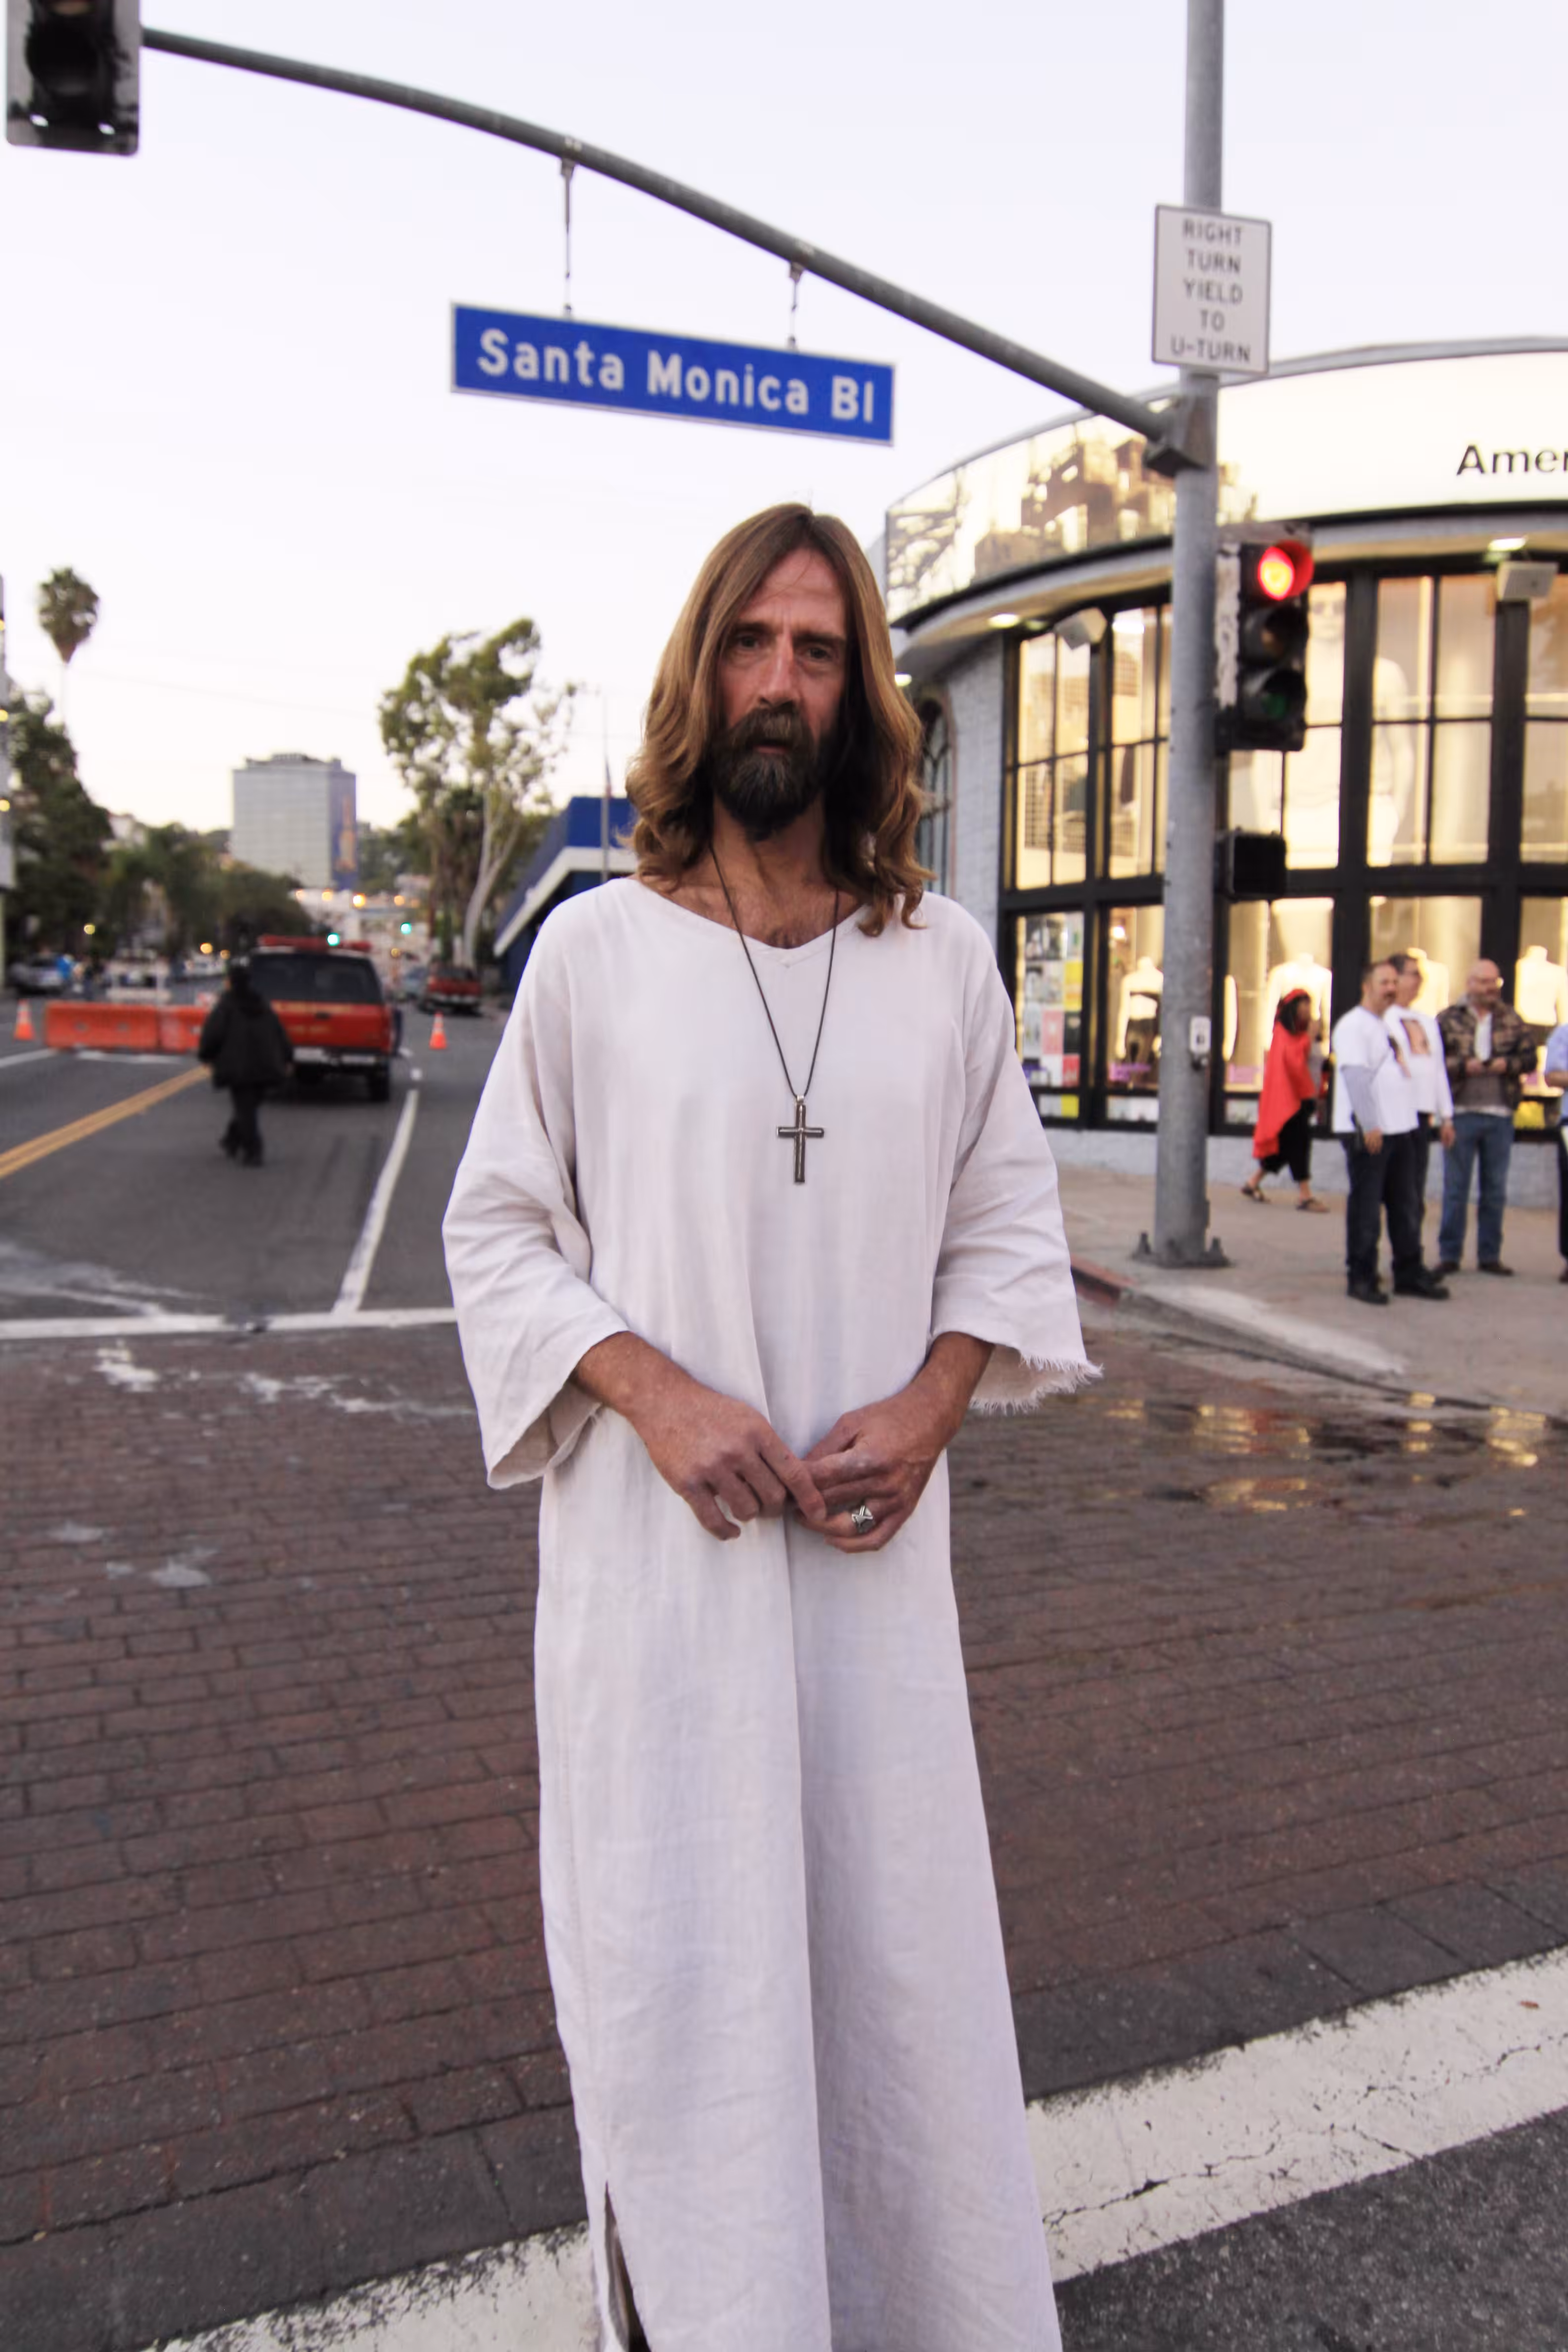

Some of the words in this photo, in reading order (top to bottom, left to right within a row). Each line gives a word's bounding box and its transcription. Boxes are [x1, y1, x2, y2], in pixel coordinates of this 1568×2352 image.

[1183, 219, 1242, 245] RIGHT
[1187, 248, 1241, 274] TURN
[1183, 278, 1243, 304] YIELD
[1200, 309, 1225, 332] TO
[1170, 334, 1251, 364] U-TURN
[477, 328, 625, 391] Santa
[647, 349, 808, 415] Monica
[831, 375, 874, 423] Bl
